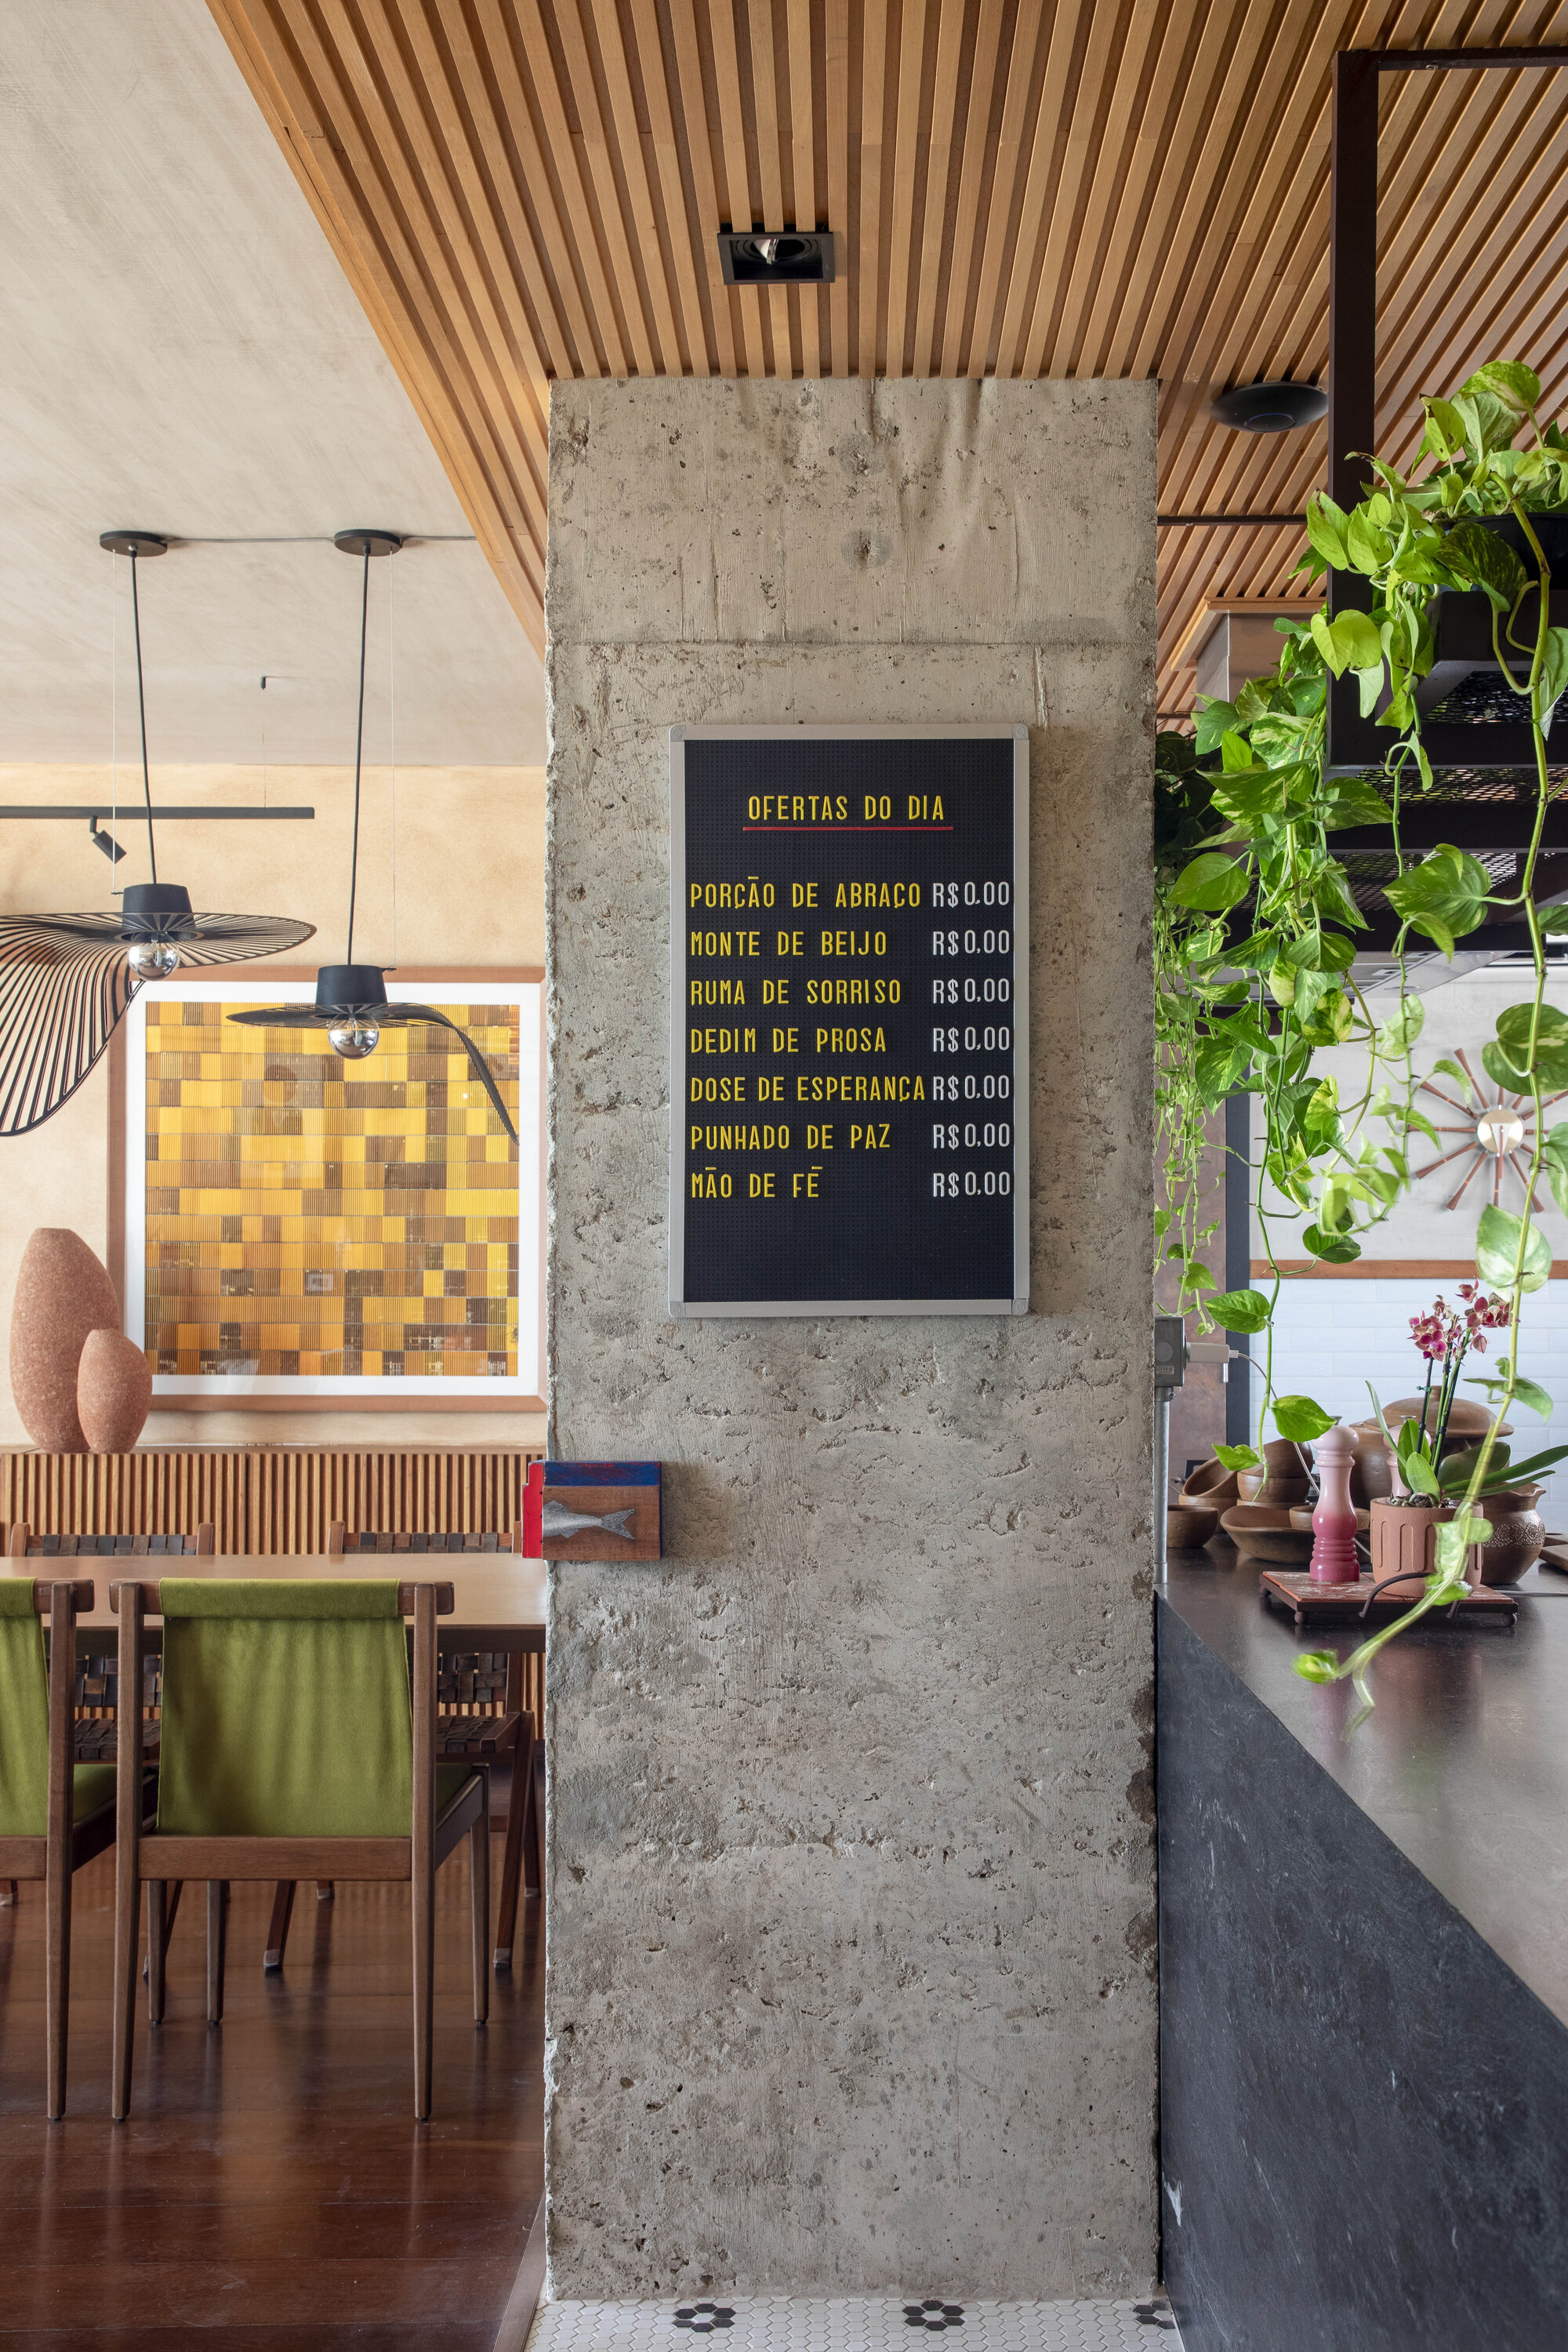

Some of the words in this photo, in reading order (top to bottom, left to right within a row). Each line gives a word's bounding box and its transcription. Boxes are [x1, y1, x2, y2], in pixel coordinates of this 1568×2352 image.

[748, 795, 848, 821] OFERTAS
[865, 795, 891, 821] DO
[908, 795, 944, 821] DIA
[792, 882, 818, 908] DE
[835, 882, 920, 909] ABRAÇO
[691, 931, 760, 956] MONTE
[777, 931, 804, 956] DE
[821, 931, 887, 956] BEIJO
[691, 979, 746, 1006] RUMA
[763, 979, 789, 1005] DE
[807, 978, 901, 1004] SORRISO
[691, 1028, 756, 1054] DEDIM
[772, 1027, 799, 1053] DE
[816, 1027, 886, 1053] PROSA
[691, 1076, 746, 1102] DOSE
[758, 1076, 785, 1102] DE
[797, 1075, 925, 1102] ESPERANÇA
[691, 1124, 789, 1151] PUNHADO
[807, 1124, 833, 1149] DE
[851, 1123, 891, 1149] PAZ
[749, 1173, 775, 1198] DE
